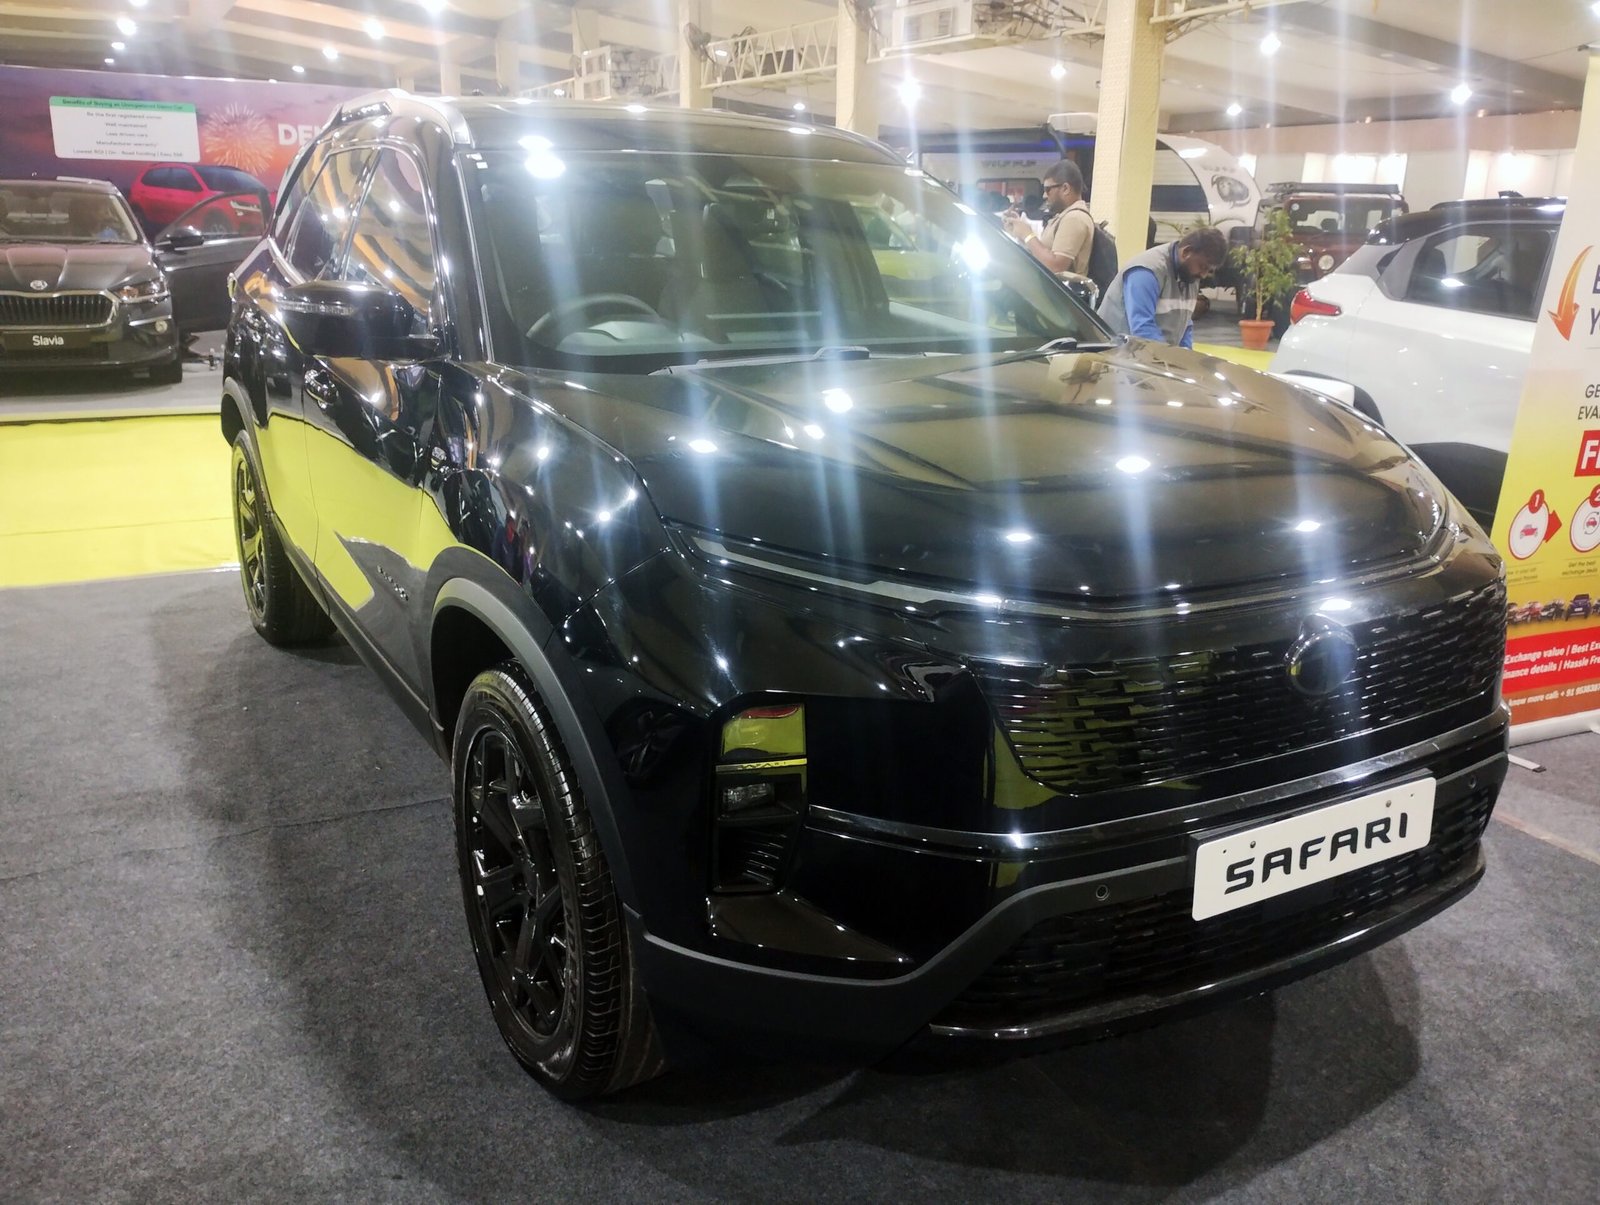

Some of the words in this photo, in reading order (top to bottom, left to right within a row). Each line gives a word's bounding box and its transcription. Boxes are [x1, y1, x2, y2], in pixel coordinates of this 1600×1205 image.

[1590, 308, 1600, 335] Y
[32, 335, 64, 346] Slavia
[1578, 405, 1600, 420] EVA
[1535, 494, 1540, 507] 1
[1504, 651, 1542, 664] Exchange
[1543, 647, 1565, 658] value
[1571, 643, 1589, 654] Best
[1503, 667, 1529, 680] inance
[1530, 662, 1557, 675] details
[1563, 657, 1589, 670] Hassle
[1527, 694, 1544, 703] more
[1224, 812, 1408, 895] SAFARI
